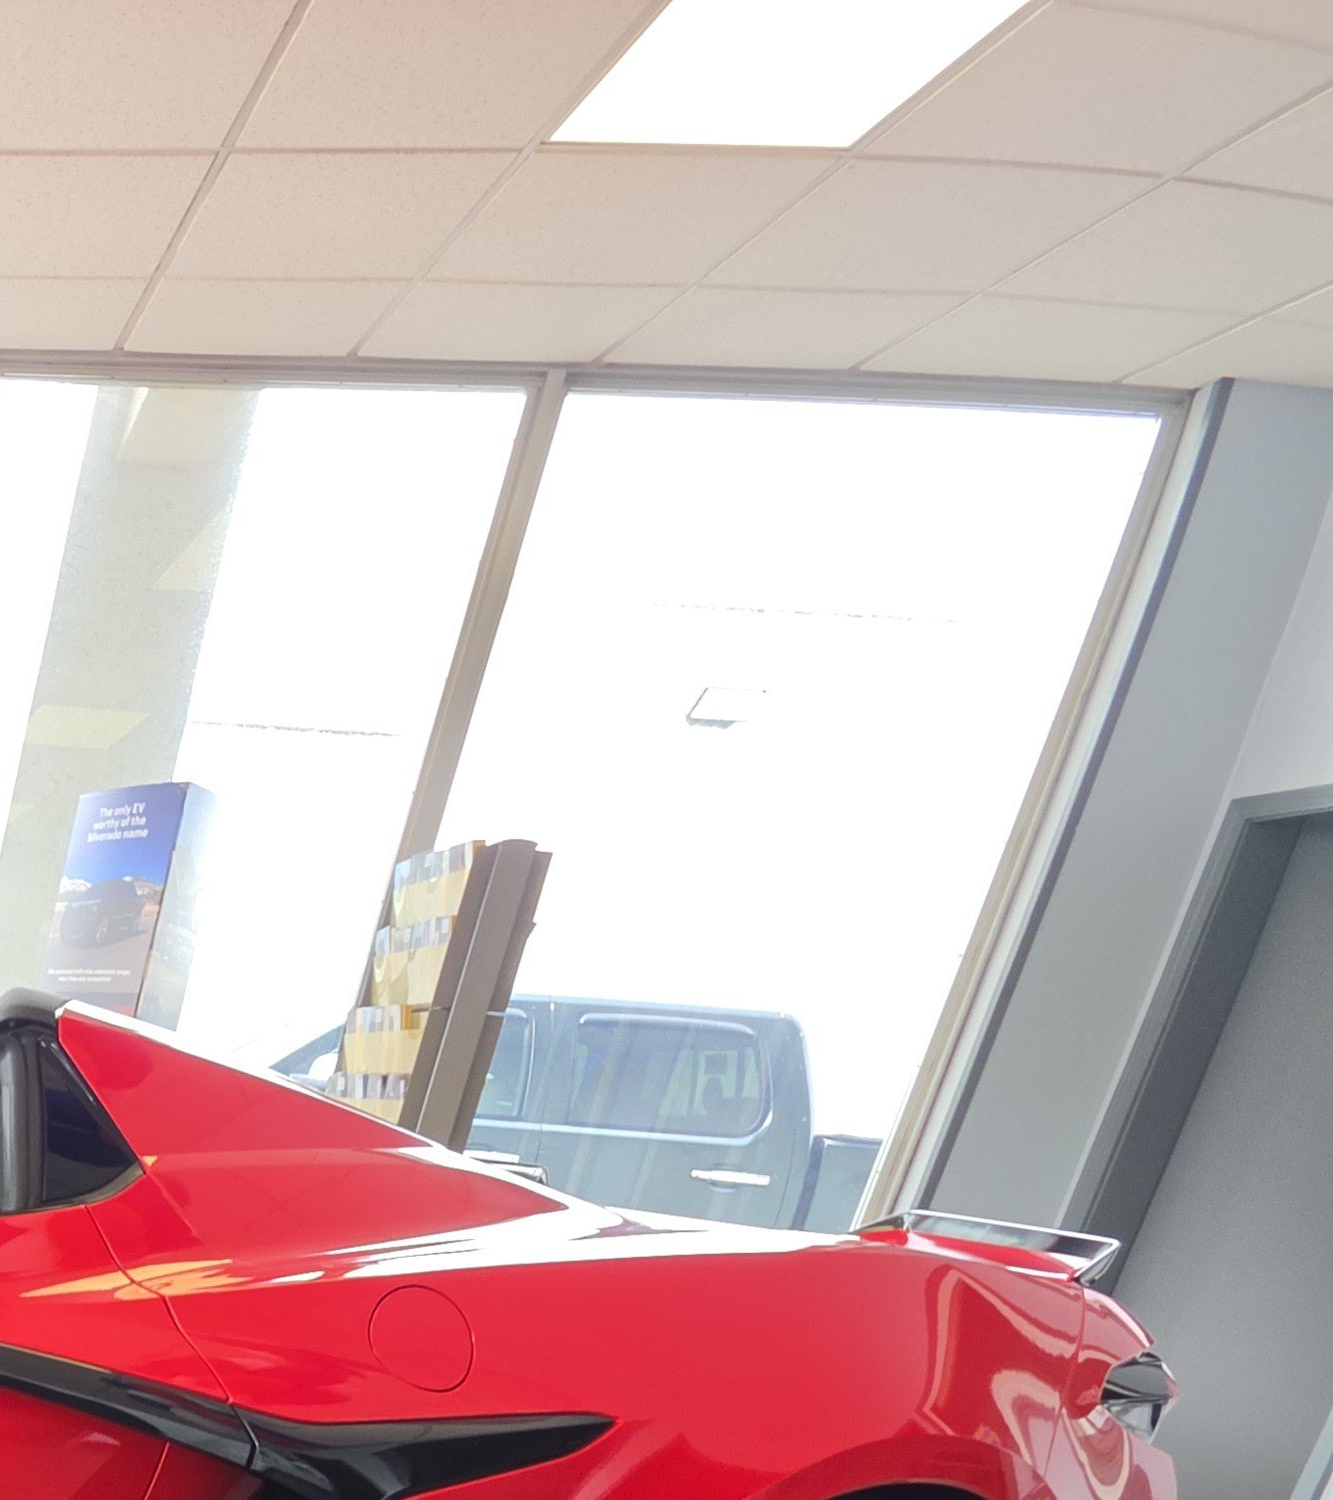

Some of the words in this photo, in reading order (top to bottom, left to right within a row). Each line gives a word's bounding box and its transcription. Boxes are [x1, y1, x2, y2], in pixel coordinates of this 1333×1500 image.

[99, 807, 113, 817] The
[114, 804, 132, 816] only
[133, 802, 146, 814] EV
[120, 816, 130, 827] of
[131, 815, 147, 826] the
[123, 828, 149, 839] name
